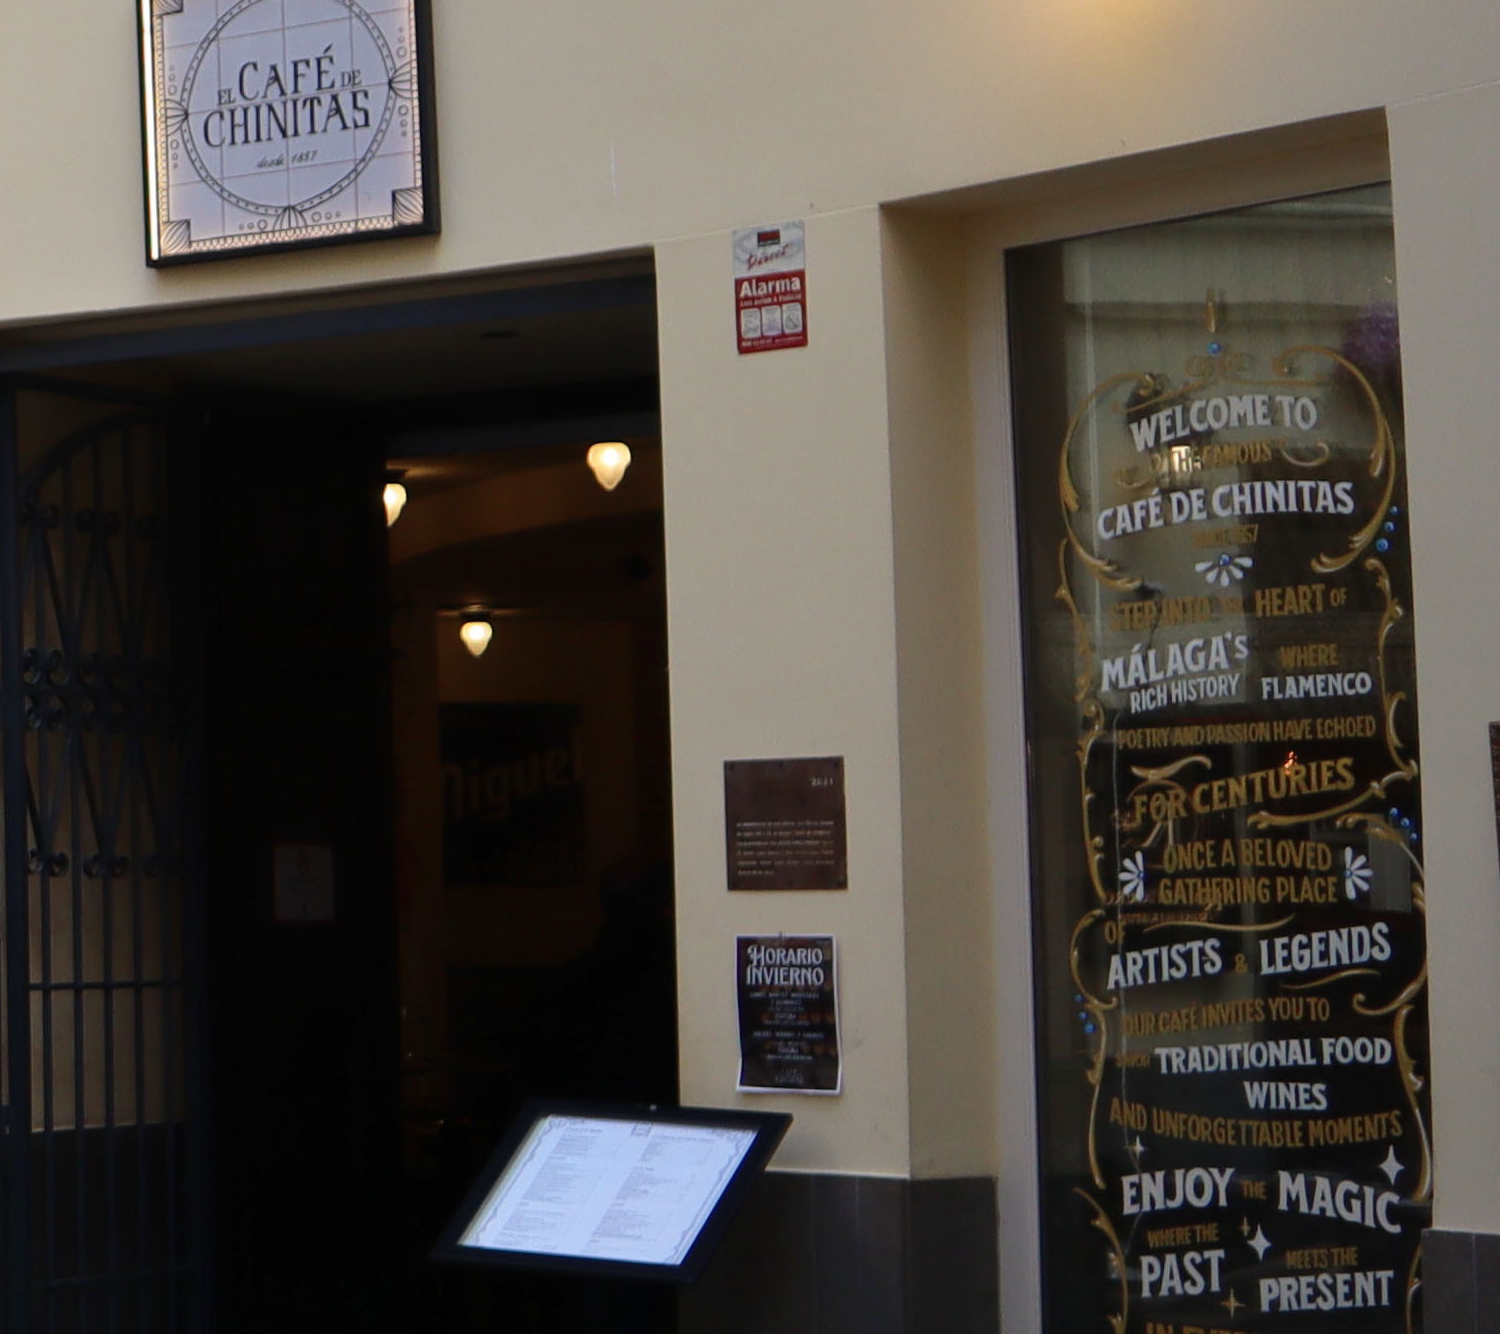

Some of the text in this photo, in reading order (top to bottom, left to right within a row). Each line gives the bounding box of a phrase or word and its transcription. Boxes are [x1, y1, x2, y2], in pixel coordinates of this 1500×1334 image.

[218, 43, 362, 106] EL CAFÉ DE
[203, 88, 371, 148] CHINITAS
[740, 276, 801, 298] Alarma
[1129, 394, 1318, 452] WELCOME TO
[1098, 484, 1164, 540] CAFÉ
[1171, 488, 1206, 524] DE
[1211, 479, 1355, 518] CHINITAS
[1255, 584, 1325, 617] HEART
[1280, 643, 1338, 667] WHERE
[1130, 673, 1240, 715] RICH HISTORY
[1261, 672, 1372, 700] FLAMENCO
[1317, 716, 1375, 739] ECHOED
[1194, 757, 1356, 815] CENTURIES
[1162, 837, 1332, 873] ONCE BELOVED
[1158, 876, 1338, 905] GATHERING PLACE
[747, 945, 823, 966] HORARIO
[1107, 921, 1392, 990] ARTISTS LEGENDS
[746, 965, 824, 986] INVIERNO
[1200, 997, 1330, 1028] INVITES YOU TO
[1155, 1038, 1317, 1075] TRADITIONAL
[1321, 1036, 1392, 1066] FOOD
[1243, 1081, 1329, 1111] WINES
[1109, 1096, 1403, 1149] AND UNFORGETTABLE MOMENTS
[1121, 1167, 1402, 1235] ENJOY MAGIC
[1140, 1249, 1225, 1299] PAST
[1259, 1269, 1395, 1313] PRESENT
